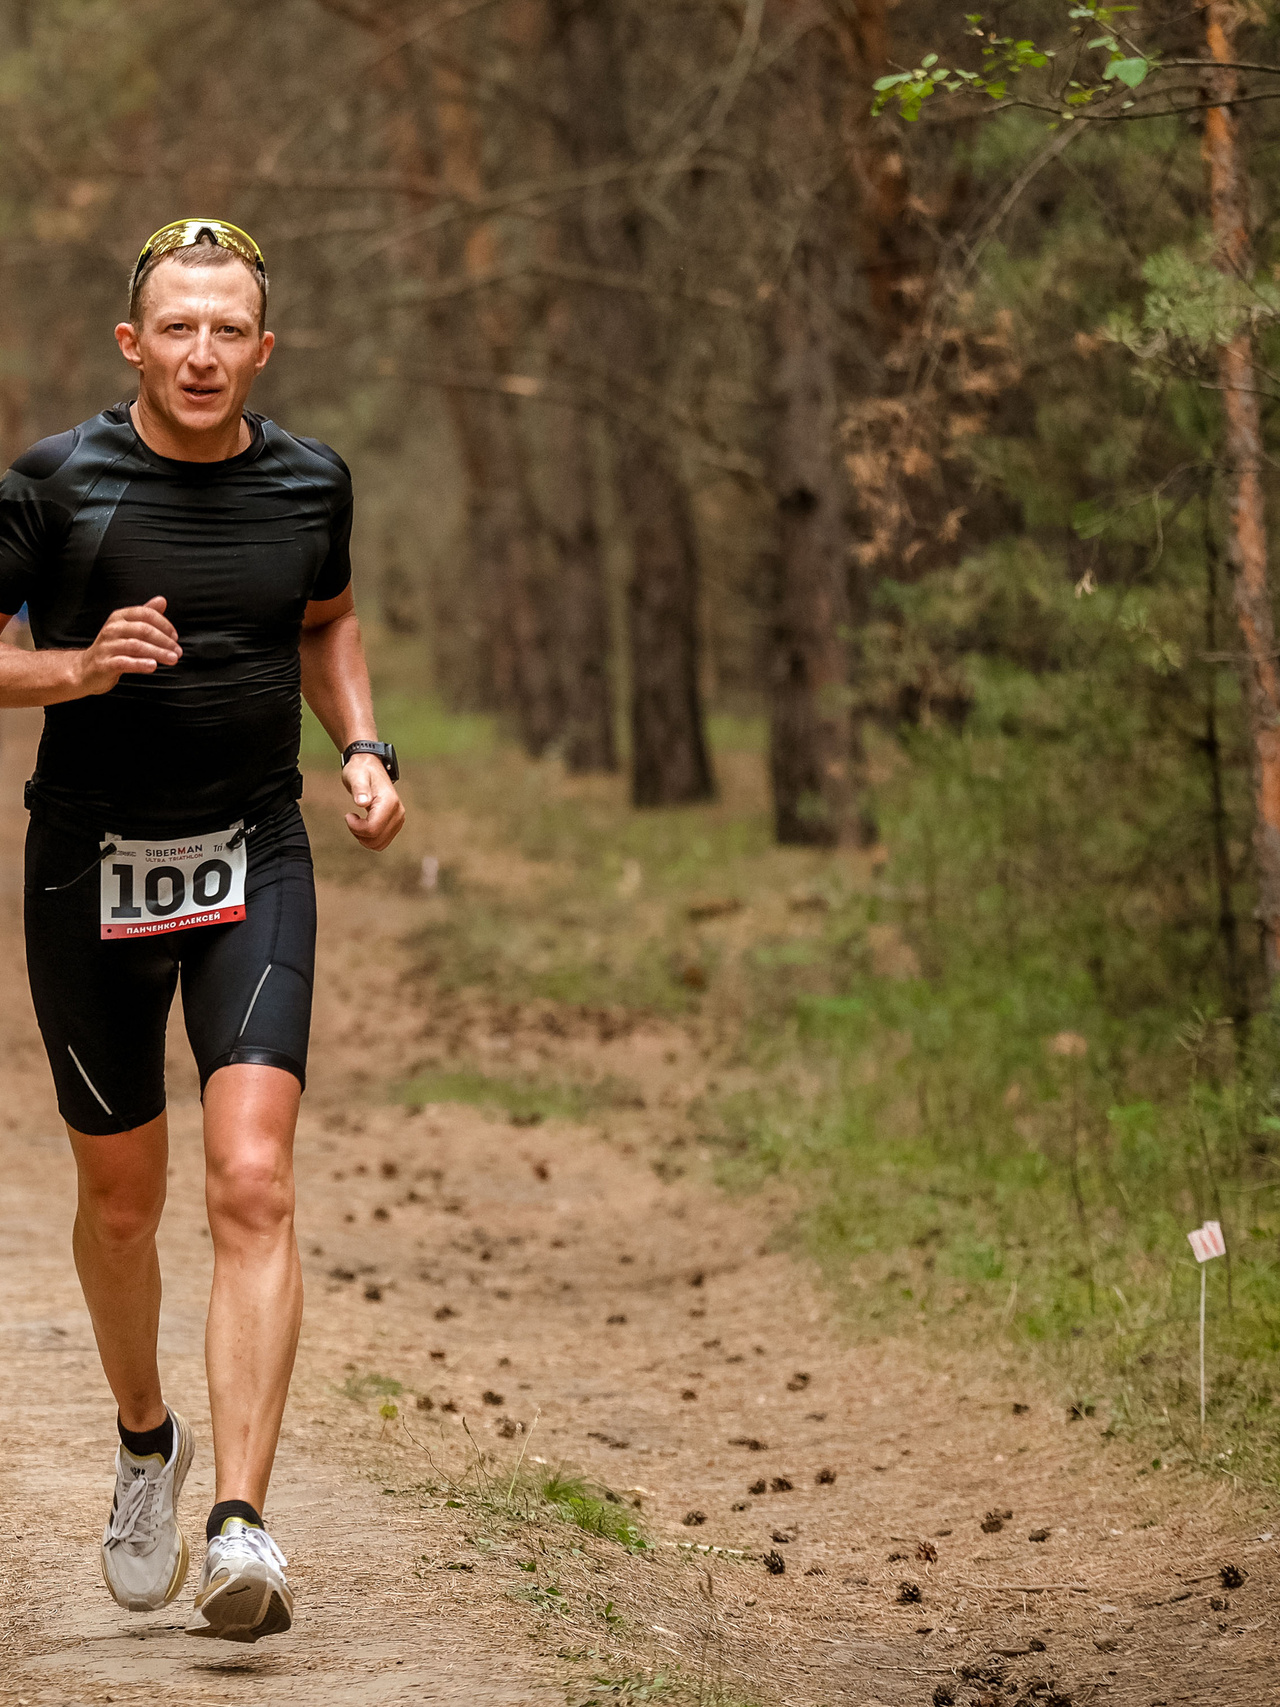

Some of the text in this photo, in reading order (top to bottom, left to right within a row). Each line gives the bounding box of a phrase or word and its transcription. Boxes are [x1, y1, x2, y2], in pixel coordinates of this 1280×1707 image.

[145, 844, 203, 857] SIBERMAN
[168, 853, 203, 862] TRIATHLON
[111, 859, 233, 919] 100
[126, 911, 221, 935] ПАНЧЕНКО АЛЕКСЕЙ
